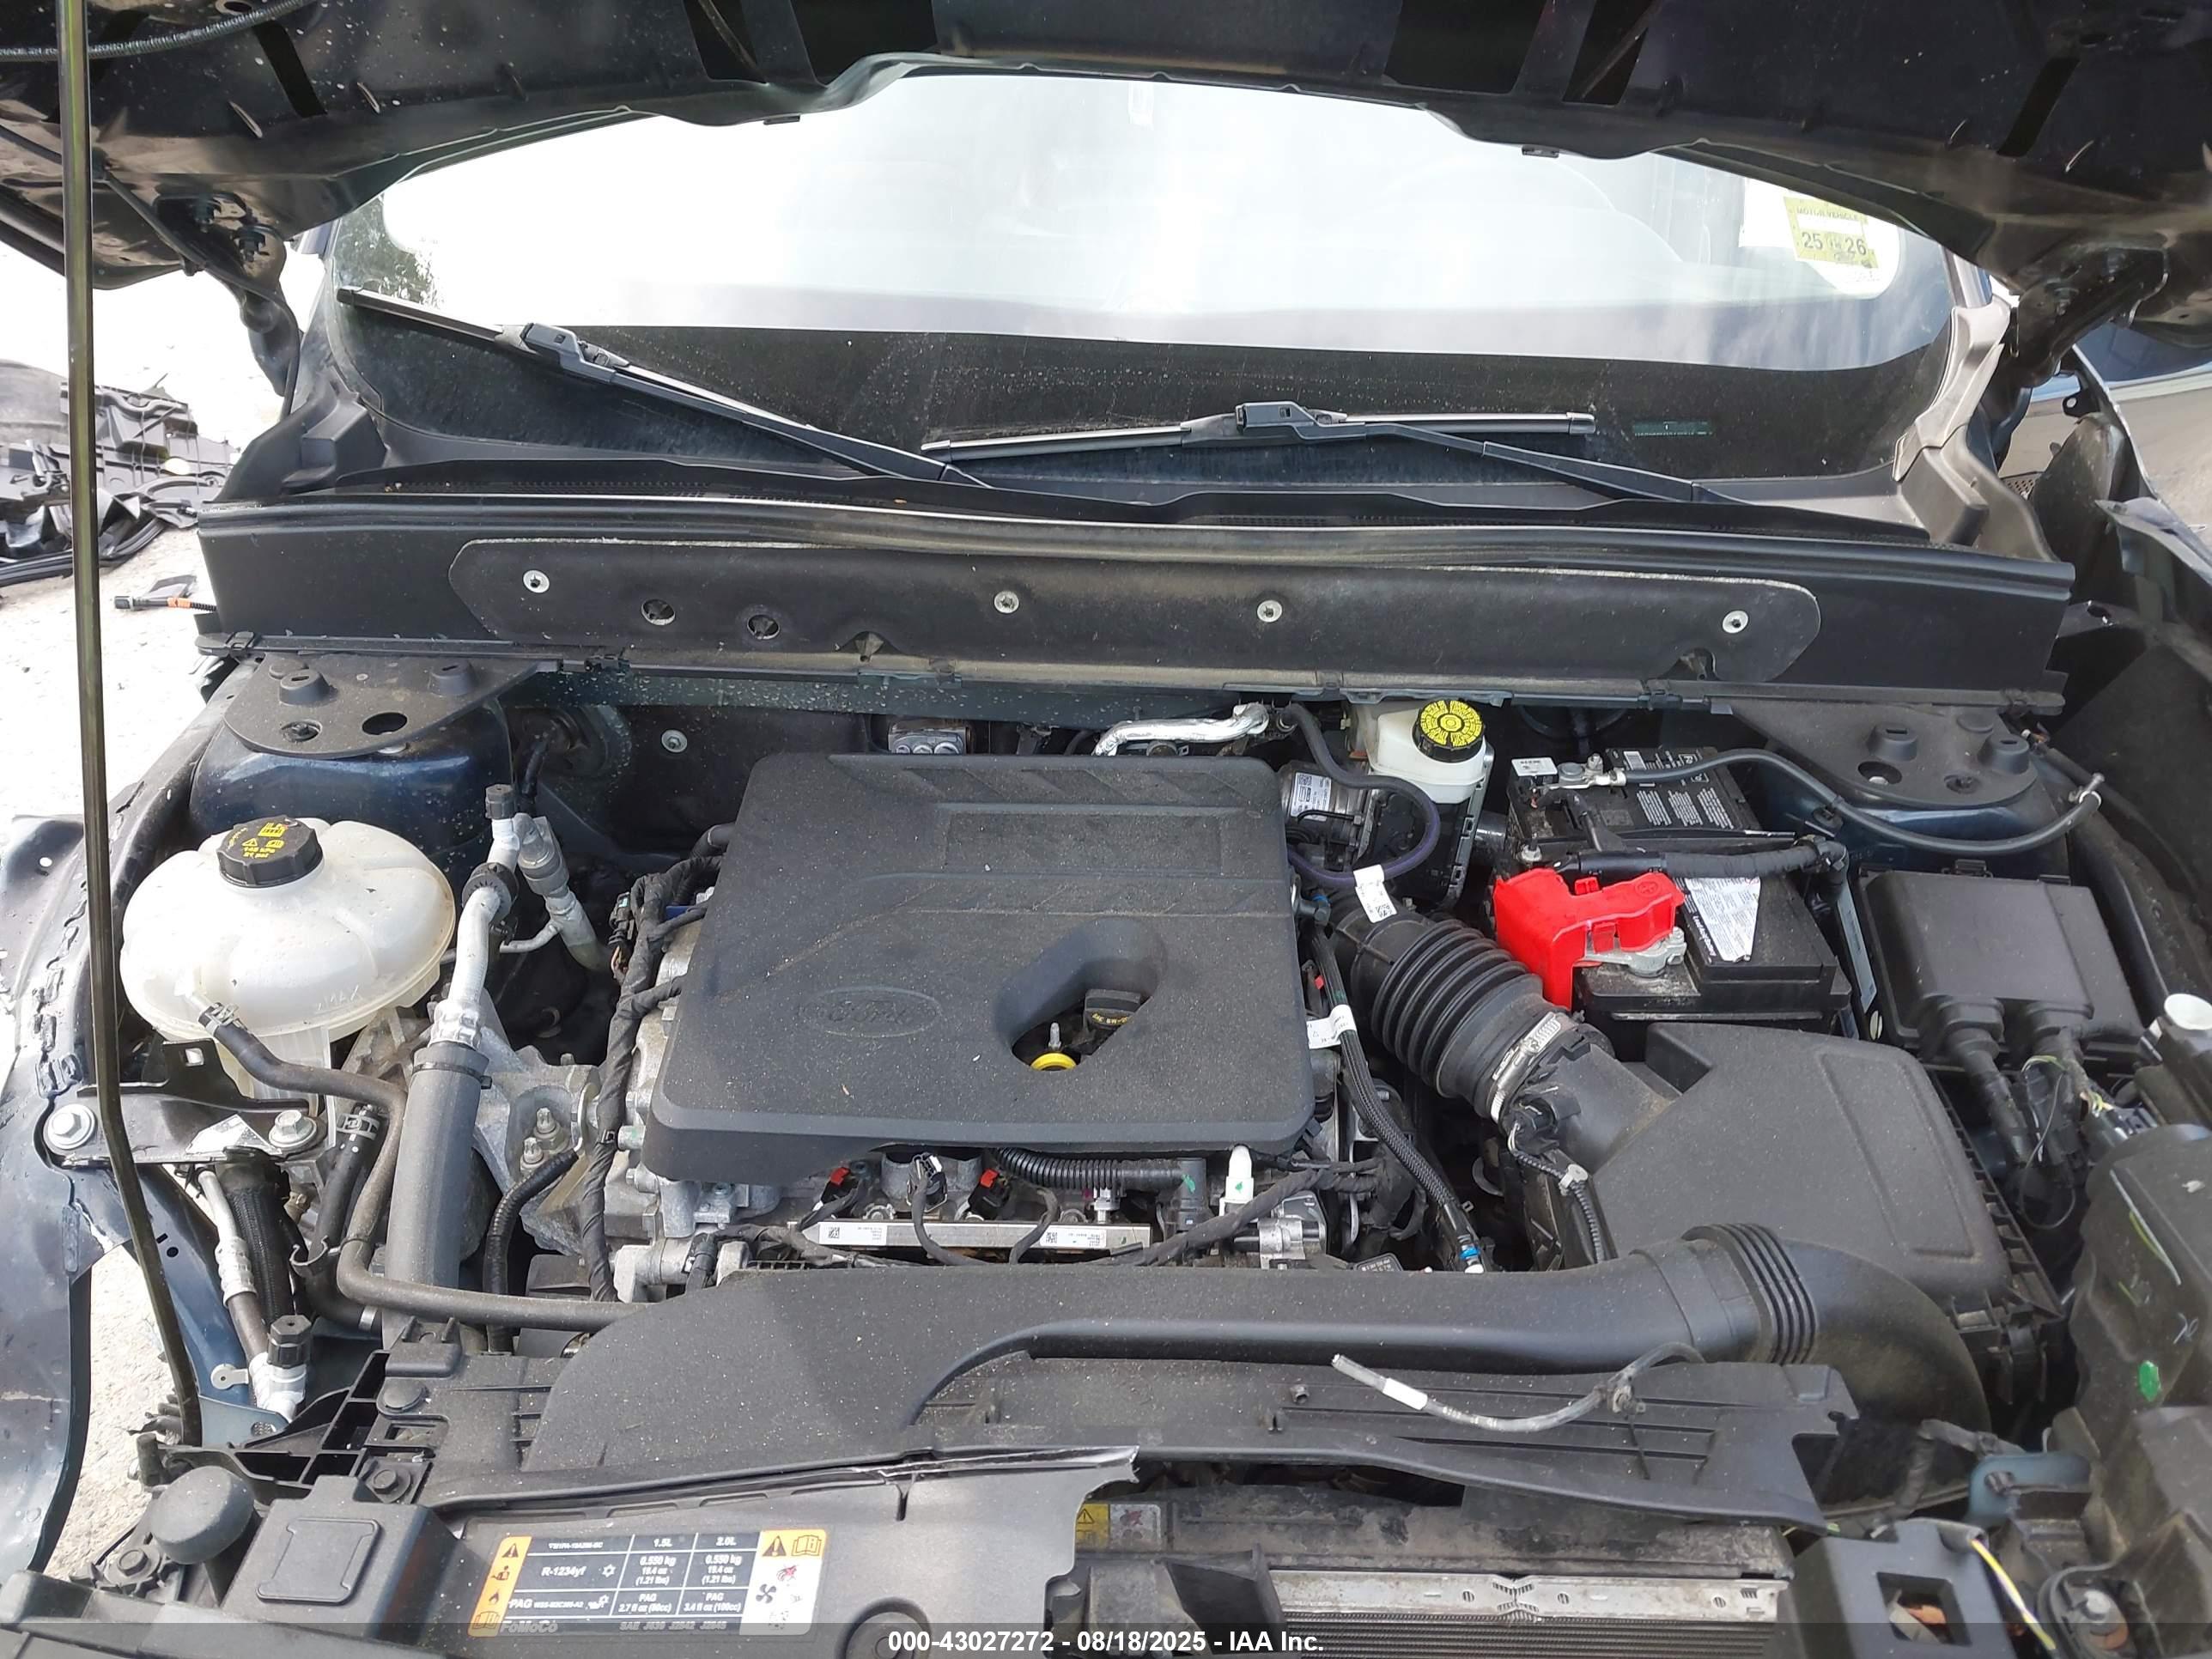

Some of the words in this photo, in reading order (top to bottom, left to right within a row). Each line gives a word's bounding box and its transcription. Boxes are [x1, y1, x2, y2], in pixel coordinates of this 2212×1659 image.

[1802, 232, 1824, 250] 25
[1844, 237, 1867, 255] 26
[653, 1538, 673, 1547] 1.5L
[715, 1536, 738, 1547] 2.0L
[664, 1556, 677, 1567] kg
[729, 1554, 743, 1566] kg
[541, 1565, 587, 1578] R-1234yf
[638, 1593, 658, 1602] PAG
[705, 1592, 725, 1601] PAG
[501, 1620, 559, 1633] FoMoCo
[619, 1621, 641, 1631] SAE
